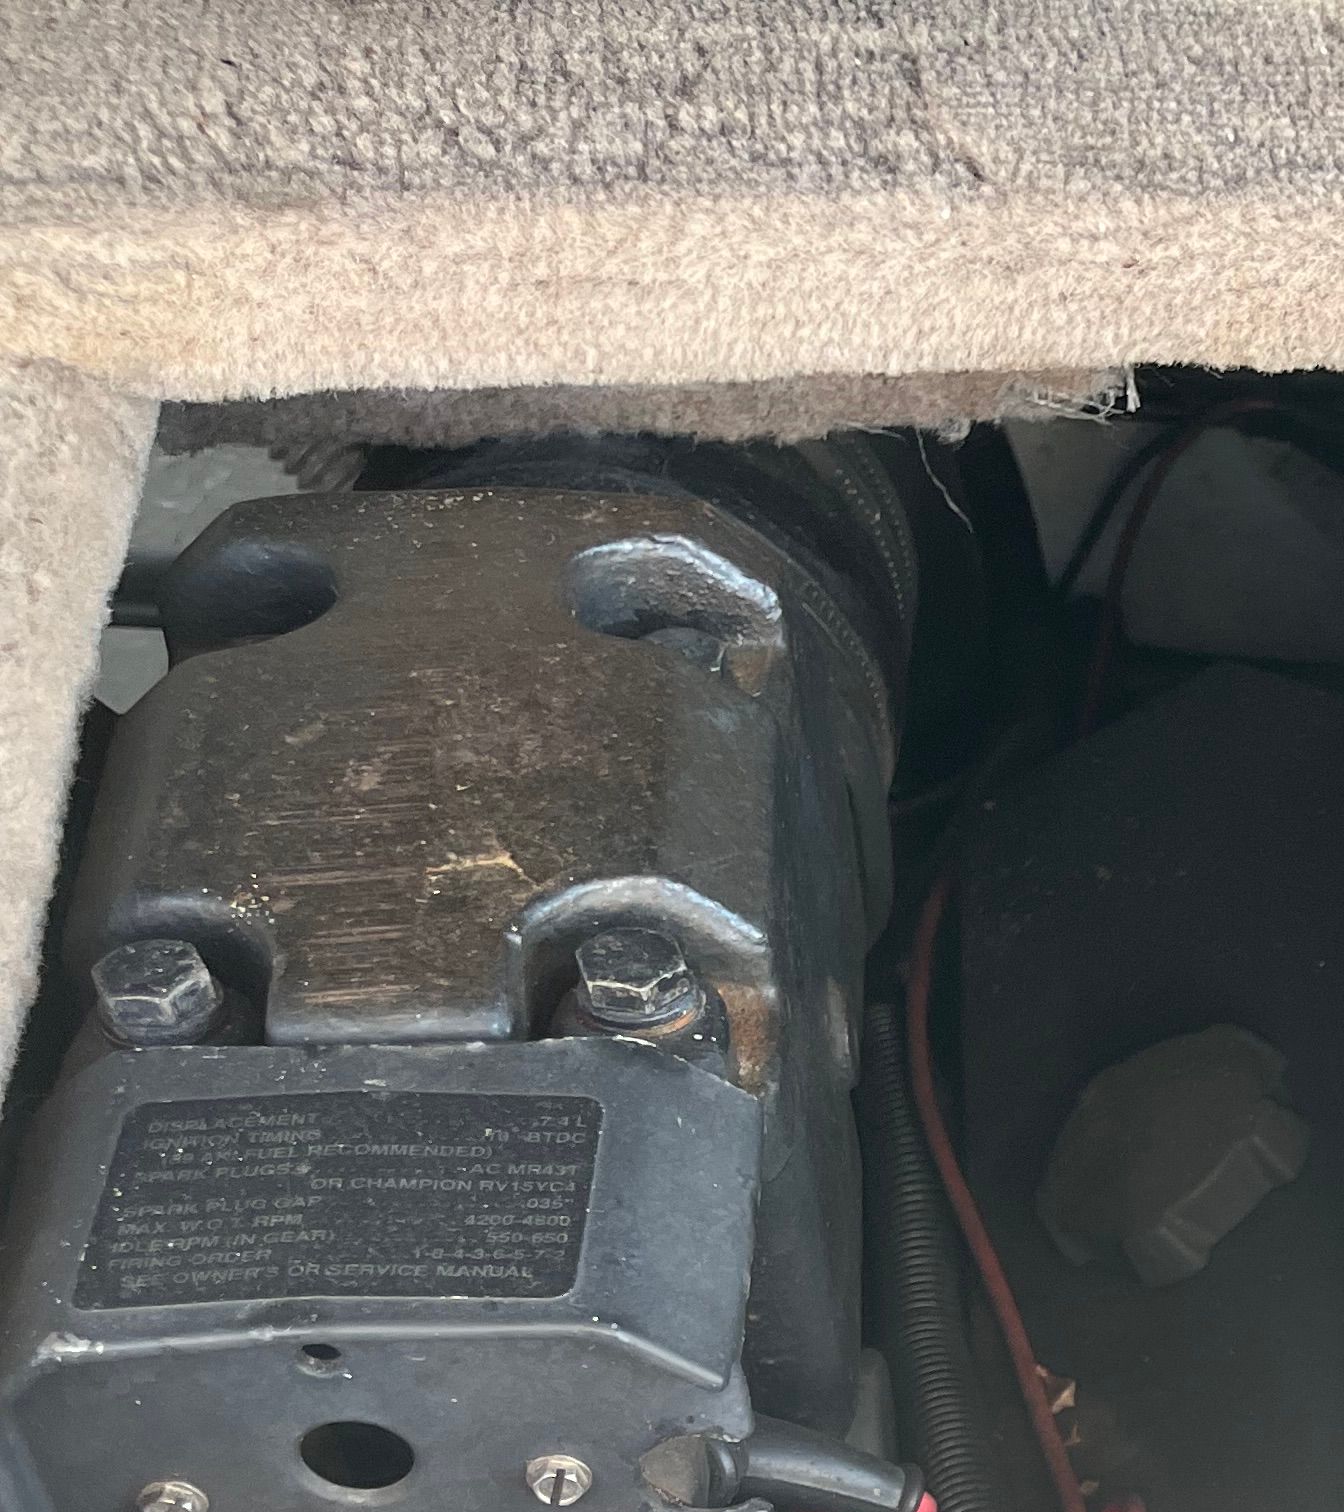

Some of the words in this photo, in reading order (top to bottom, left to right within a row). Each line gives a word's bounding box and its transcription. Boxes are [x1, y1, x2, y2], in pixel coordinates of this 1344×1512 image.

[148, 1112, 322, 1134] DISPLACEMENT
[248, 1129, 322, 1144] TIMING
[245, 1145, 300, 1160] FUEL
[307, 1143, 493, 1159] RECOMMENDED)
[470, 1163, 503, 1176] AC
[311, 1177, 343, 1191] OR
[350, 1178, 472, 1193] CHAMPION
[273, 1195, 324, 1210] GAP
[252, 1213, 304, 1229] RPM
[107, 1254, 182, 1272] FIRING
[190, 1248, 274, 1266] ORDER
[287, 1262, 321, 1279] OR
[324, 1262, 431, 1279] SERVICE
[436, 1264, 534, 1279] MANUAL
